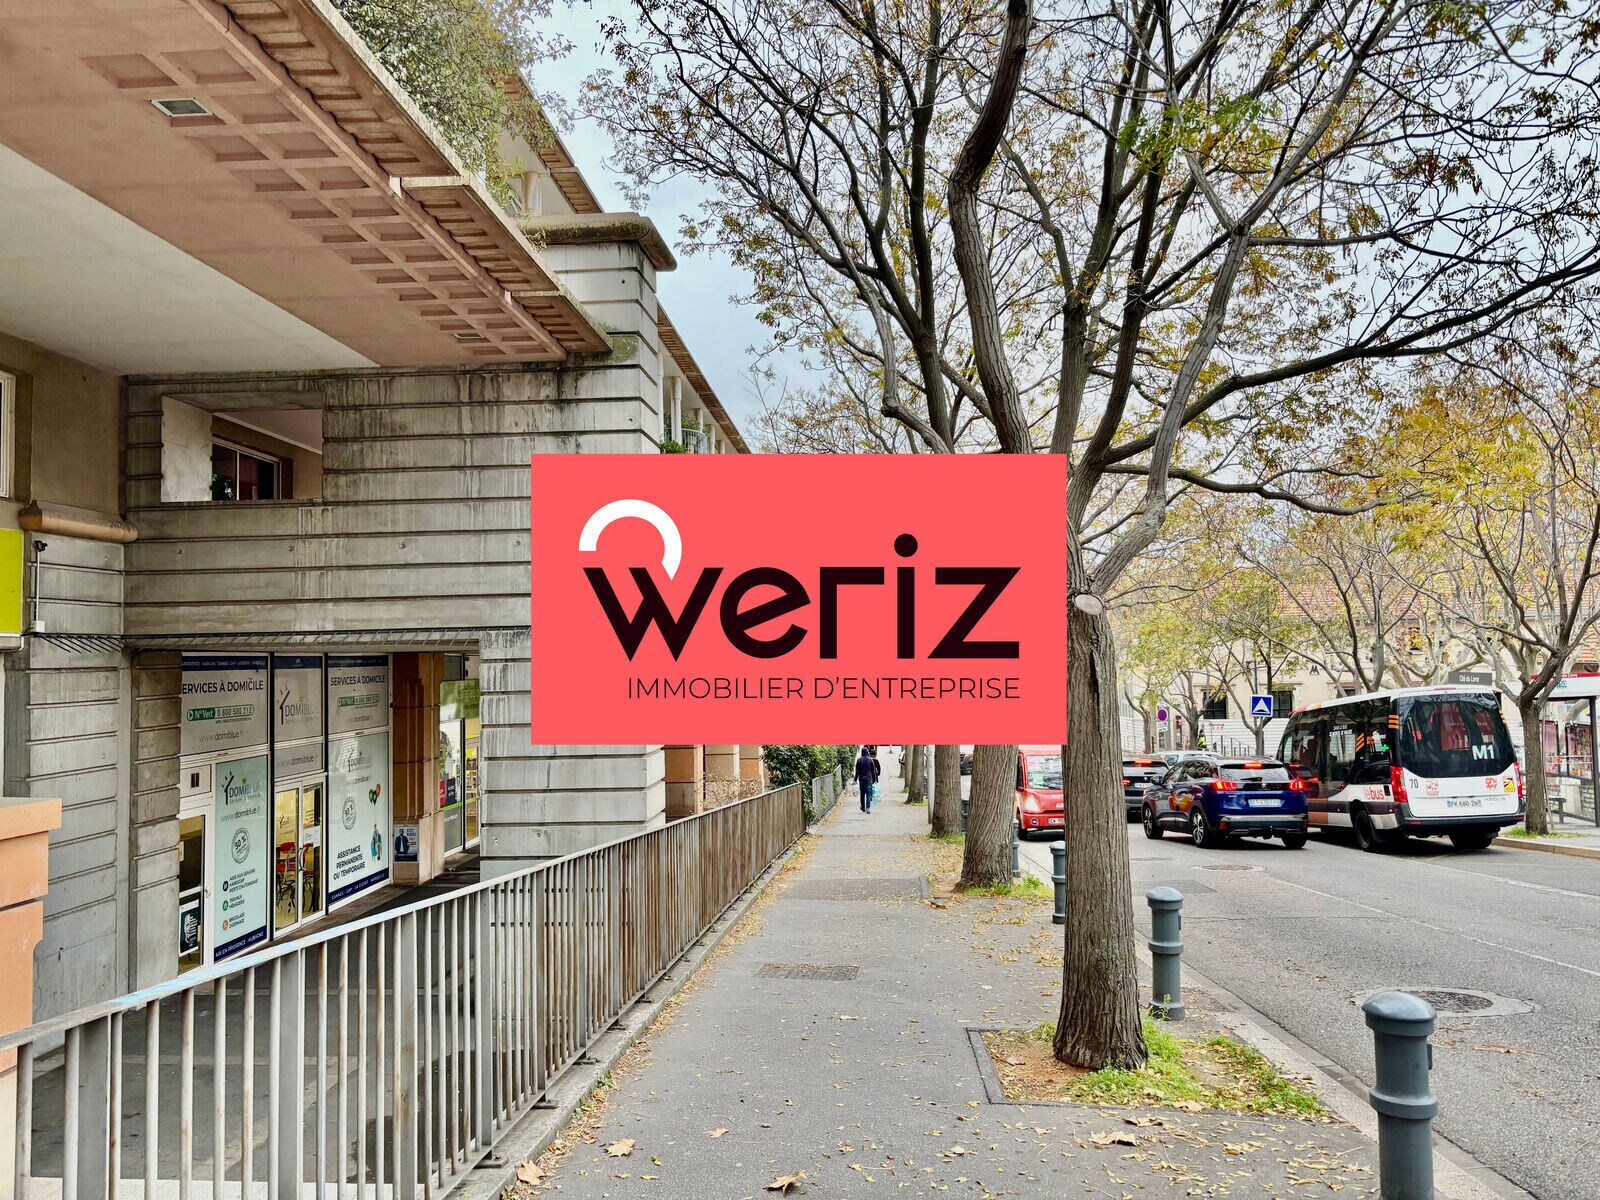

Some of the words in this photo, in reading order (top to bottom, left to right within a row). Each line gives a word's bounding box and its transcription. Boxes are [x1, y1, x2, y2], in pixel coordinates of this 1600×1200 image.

[182, 682, 218, 694] ERVICES
[219, 679, 225, 692] À
[227, 680, 264, 692] DOMICILE
[330, 676, 356, 686] SERVICES
[357, 674, 361, 684] À
[362, 674, 386, 684] DOMICILE
[203, 709, 214, 718] Vert
[1472, 744, 1495, 760] M1
[1409, 778, 1419, 789] 70
[337, 845, 360, 859] ASSISTANCE
[336, 853, 363, 869] PERMANENTE
[340, 861, 365, 877] TEMPORAIRE
